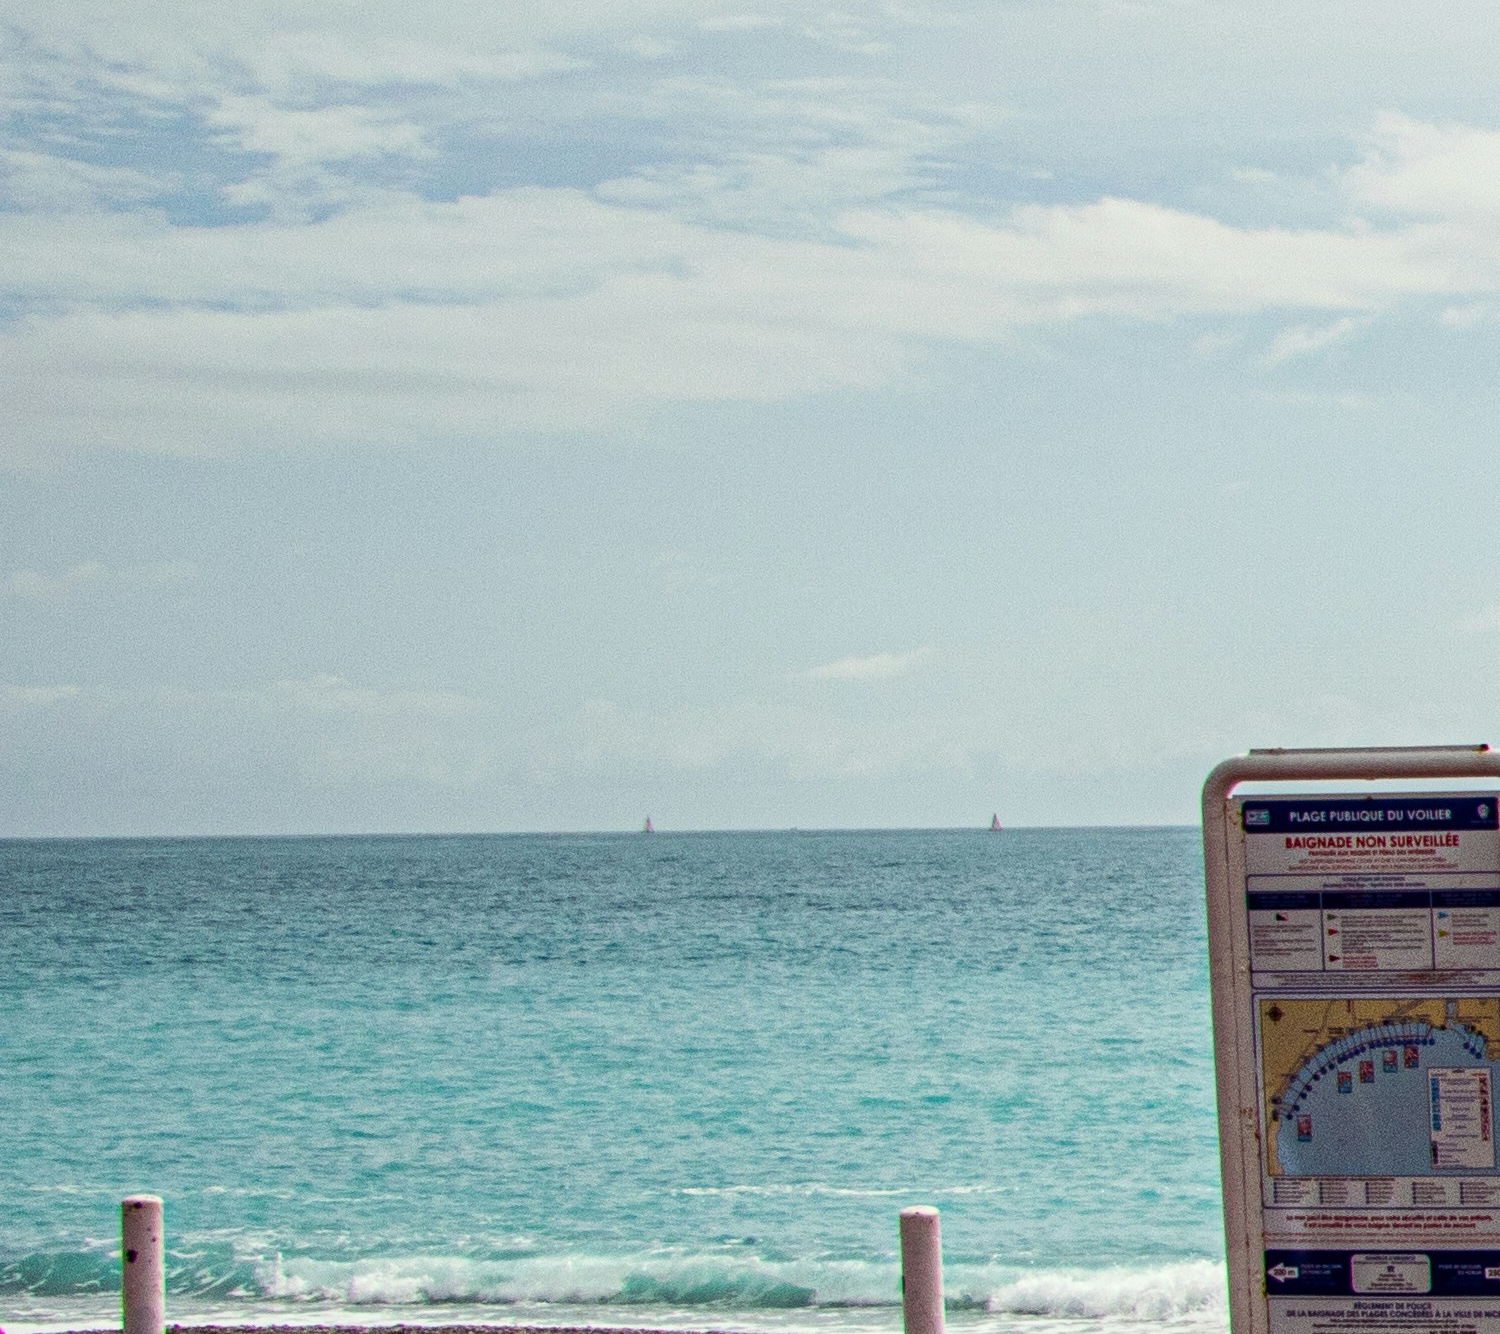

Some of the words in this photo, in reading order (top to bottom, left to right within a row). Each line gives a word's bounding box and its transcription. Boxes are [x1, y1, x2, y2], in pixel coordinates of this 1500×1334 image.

[1289, 811, 1326, 822] PLAGE
[1329, 810, 1384, 822] PUBLIQUE
[1387, 810, 1404, 821] DU
[1407, 809, 1452, 820] VOILIER
[1285, 835, 1352, 849] BAIGNADE
[1356, 835, 1386, 848] NON
[1390, 832, 1459, 848] SURVEILLÉE
